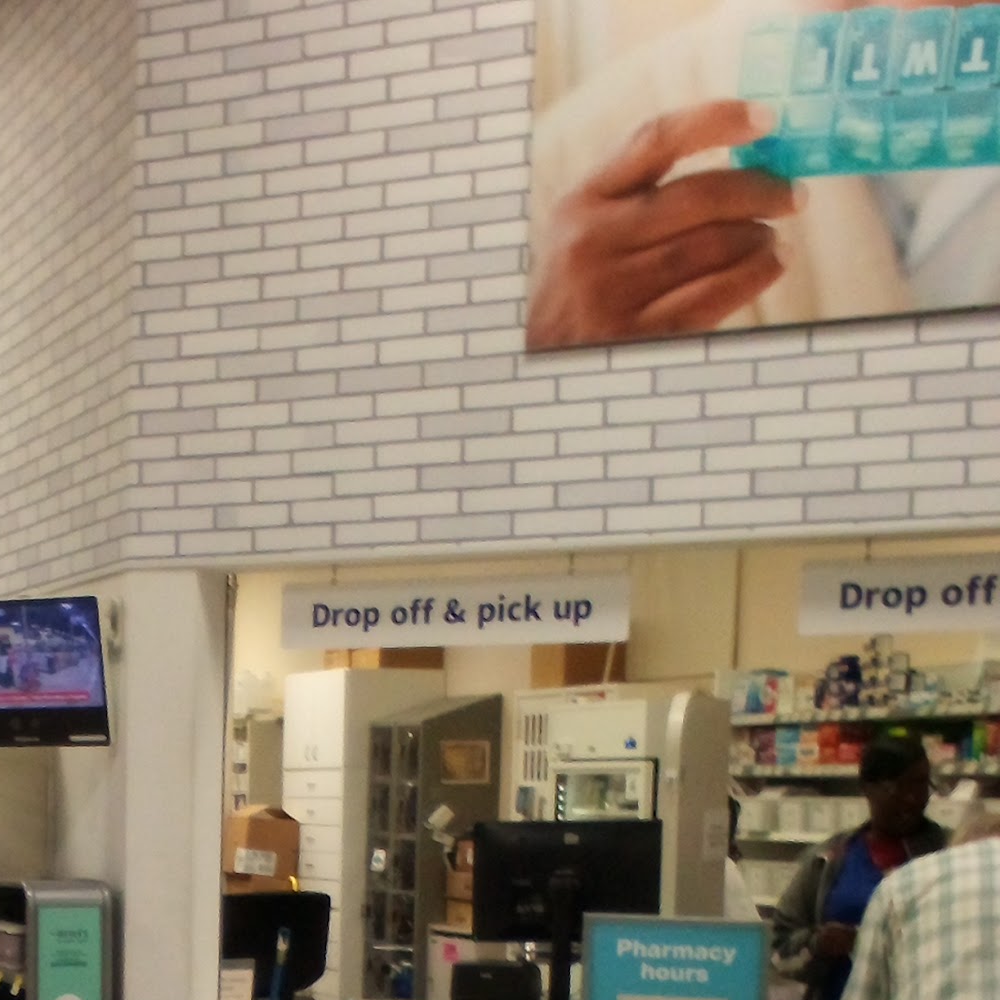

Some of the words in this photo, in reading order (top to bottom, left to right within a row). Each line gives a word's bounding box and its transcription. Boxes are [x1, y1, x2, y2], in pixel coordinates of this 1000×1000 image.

[840, 582, 928, 615] Drop
[941, 574, 998, 607] off
[312, 602, 380, 632] Drop
[391, 598, 434, 625] off
[443, 598, 466, 625] &
[477, 594, 542, 630] pick
[553, 598, 593, 626] up
[616, 938, 737, 966] Pharmacy
[641, 961, 709, 983] hours
